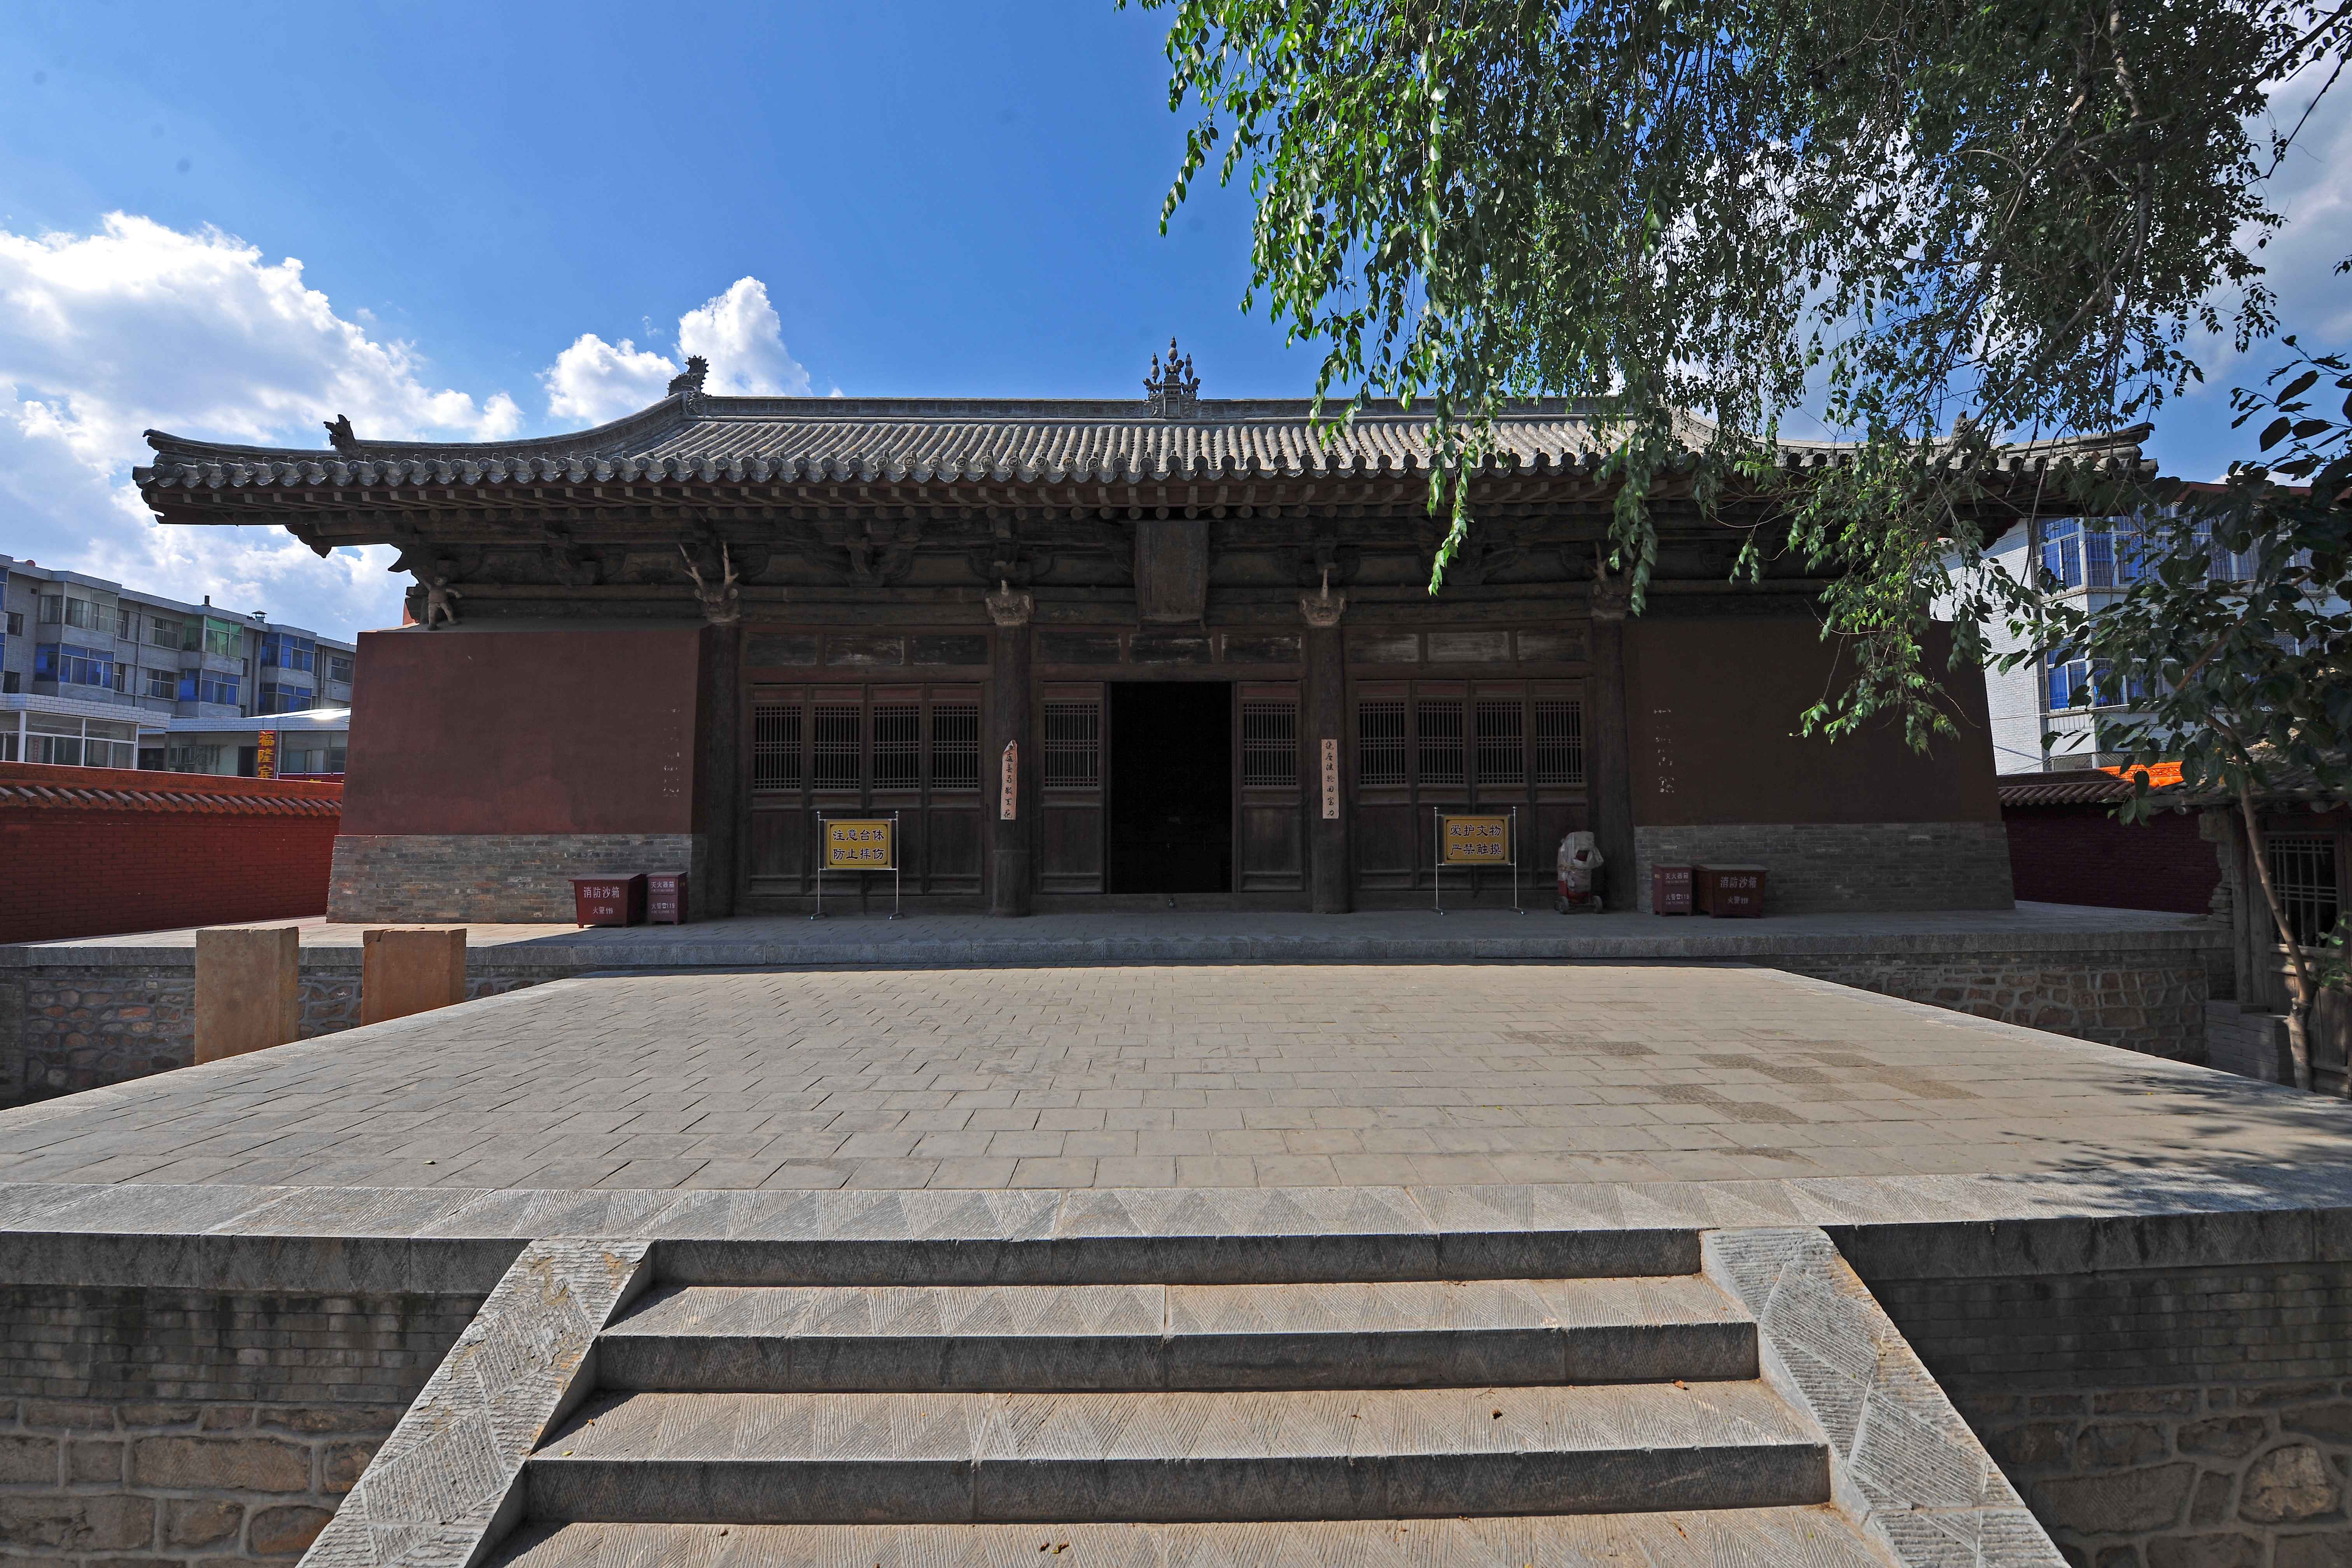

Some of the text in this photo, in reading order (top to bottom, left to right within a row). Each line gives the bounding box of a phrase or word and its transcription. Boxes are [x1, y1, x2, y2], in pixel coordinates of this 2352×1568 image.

[832, 829, 885, 842] 注意台体
[1450, 824, 1502, 837] 爱护文物
[833, 848, 885, 861] 防止摔伤
[1450, 843, 1502, 856] 严禁触摸
[1665, 872, 1689, 880] 灭火器箱
[1720, 876, 1757, 888] 消防沙箱
[583, 886, 620, 899] 消防沙箱
